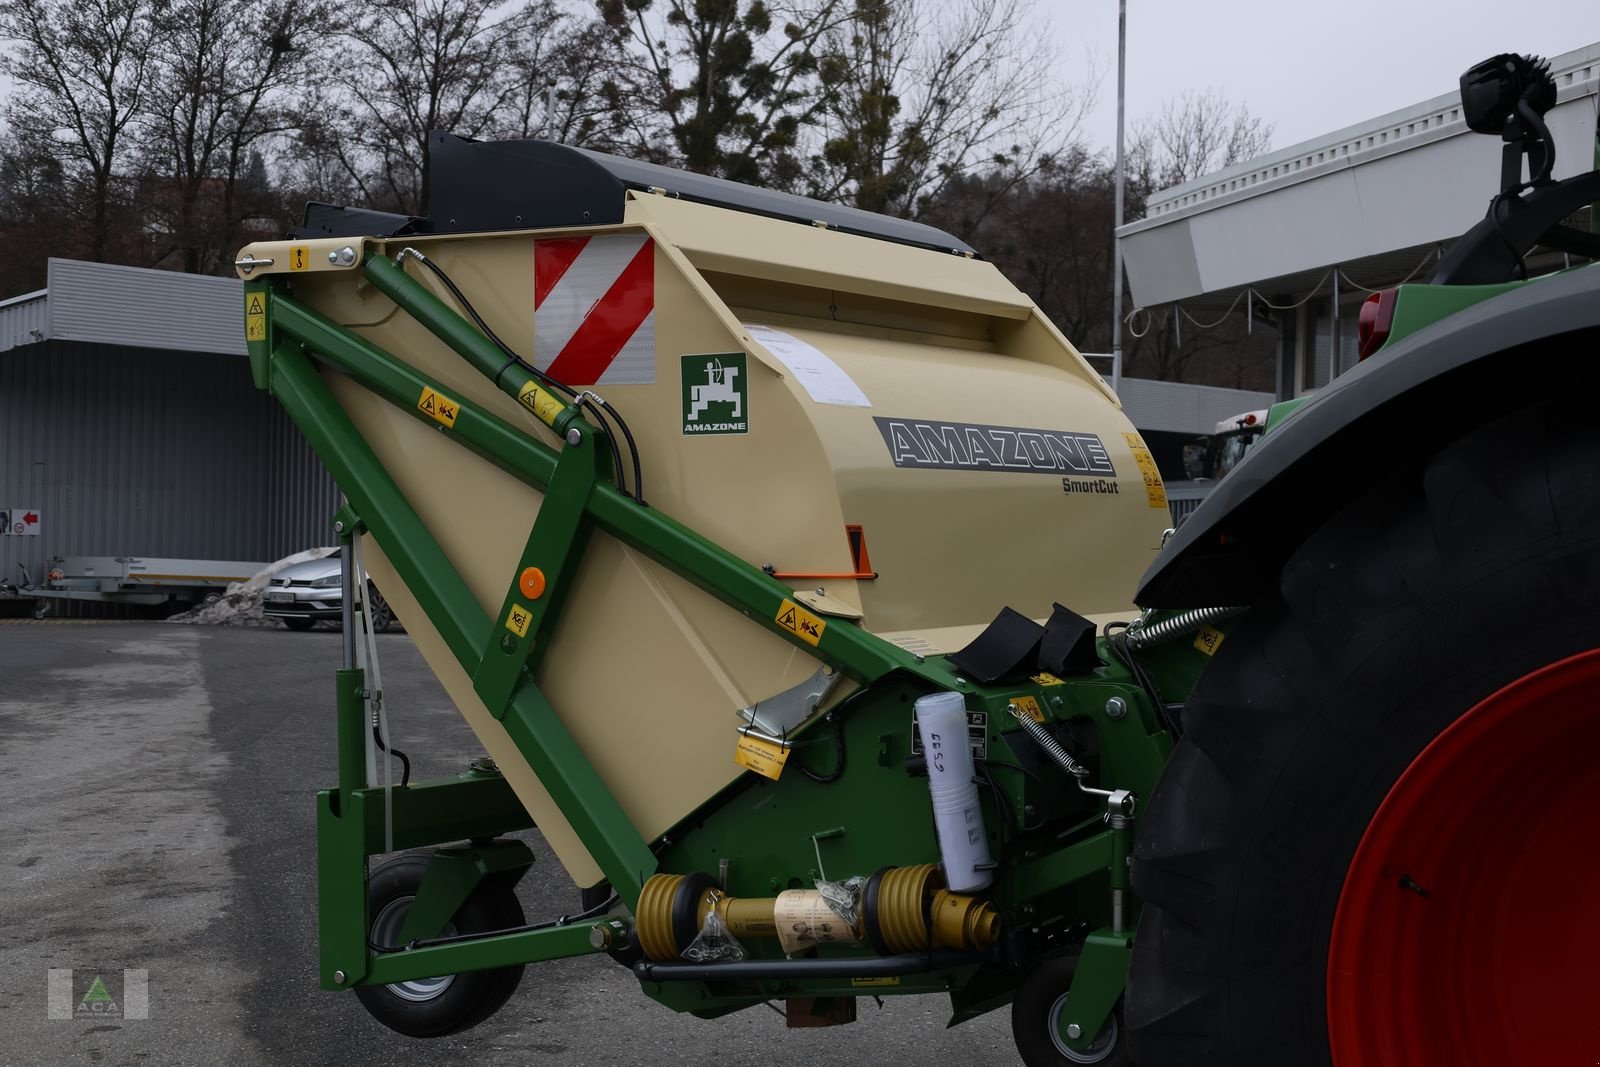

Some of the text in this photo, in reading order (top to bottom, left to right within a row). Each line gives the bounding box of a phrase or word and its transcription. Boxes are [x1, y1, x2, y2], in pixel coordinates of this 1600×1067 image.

[684, 422, 746, 432] AMAZONE
[889, 422, 1113, 472] AMAZONE
[1062, 477, 1119, 494] SmartCut
